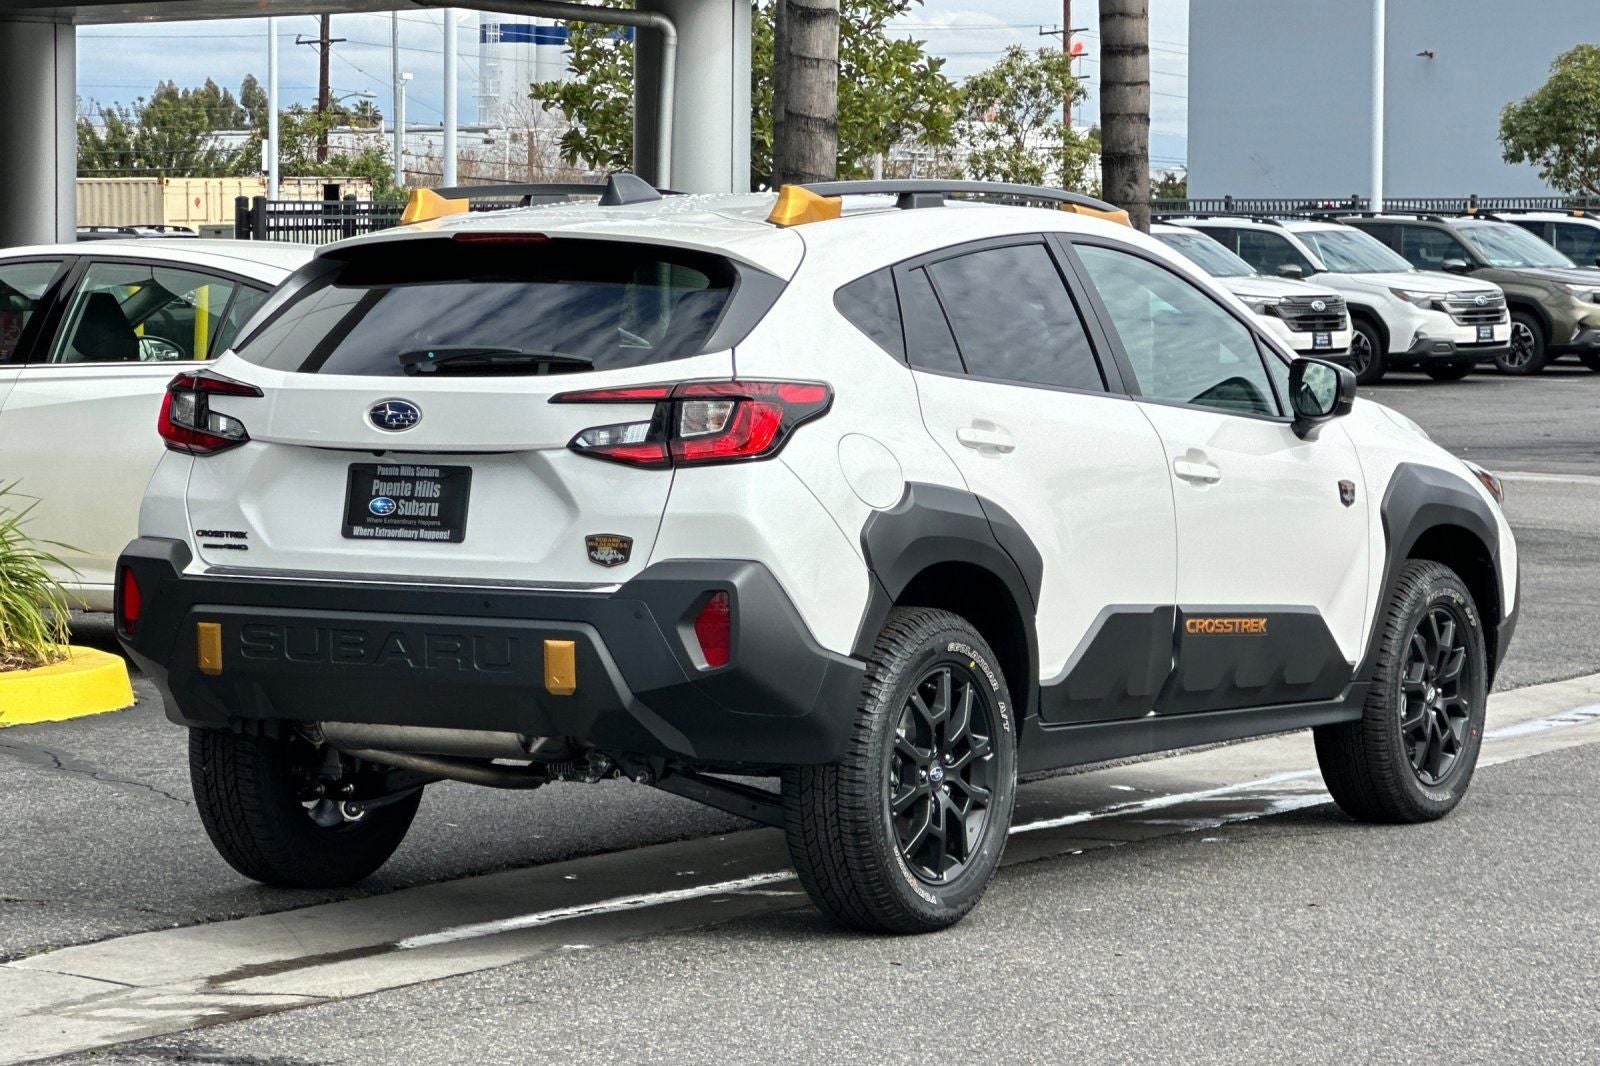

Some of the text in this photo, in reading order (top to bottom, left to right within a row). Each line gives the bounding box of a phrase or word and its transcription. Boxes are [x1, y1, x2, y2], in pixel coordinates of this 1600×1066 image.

[377, 465, 440, 477] Puente Hills Subaru
[371, 479, 441, 498] Puente Hills
[397, 499, 439, 517] Subaru
[384, 517, 416, 526] Extraordinary
[196, 529, 248, 539] CROSSTREK
[353, 526, 450, 540] Where Extraordinary Happens!
[1185, 617, 1268, 635] CROSSTREK
[240, 623, 519, 673] SUBARU
